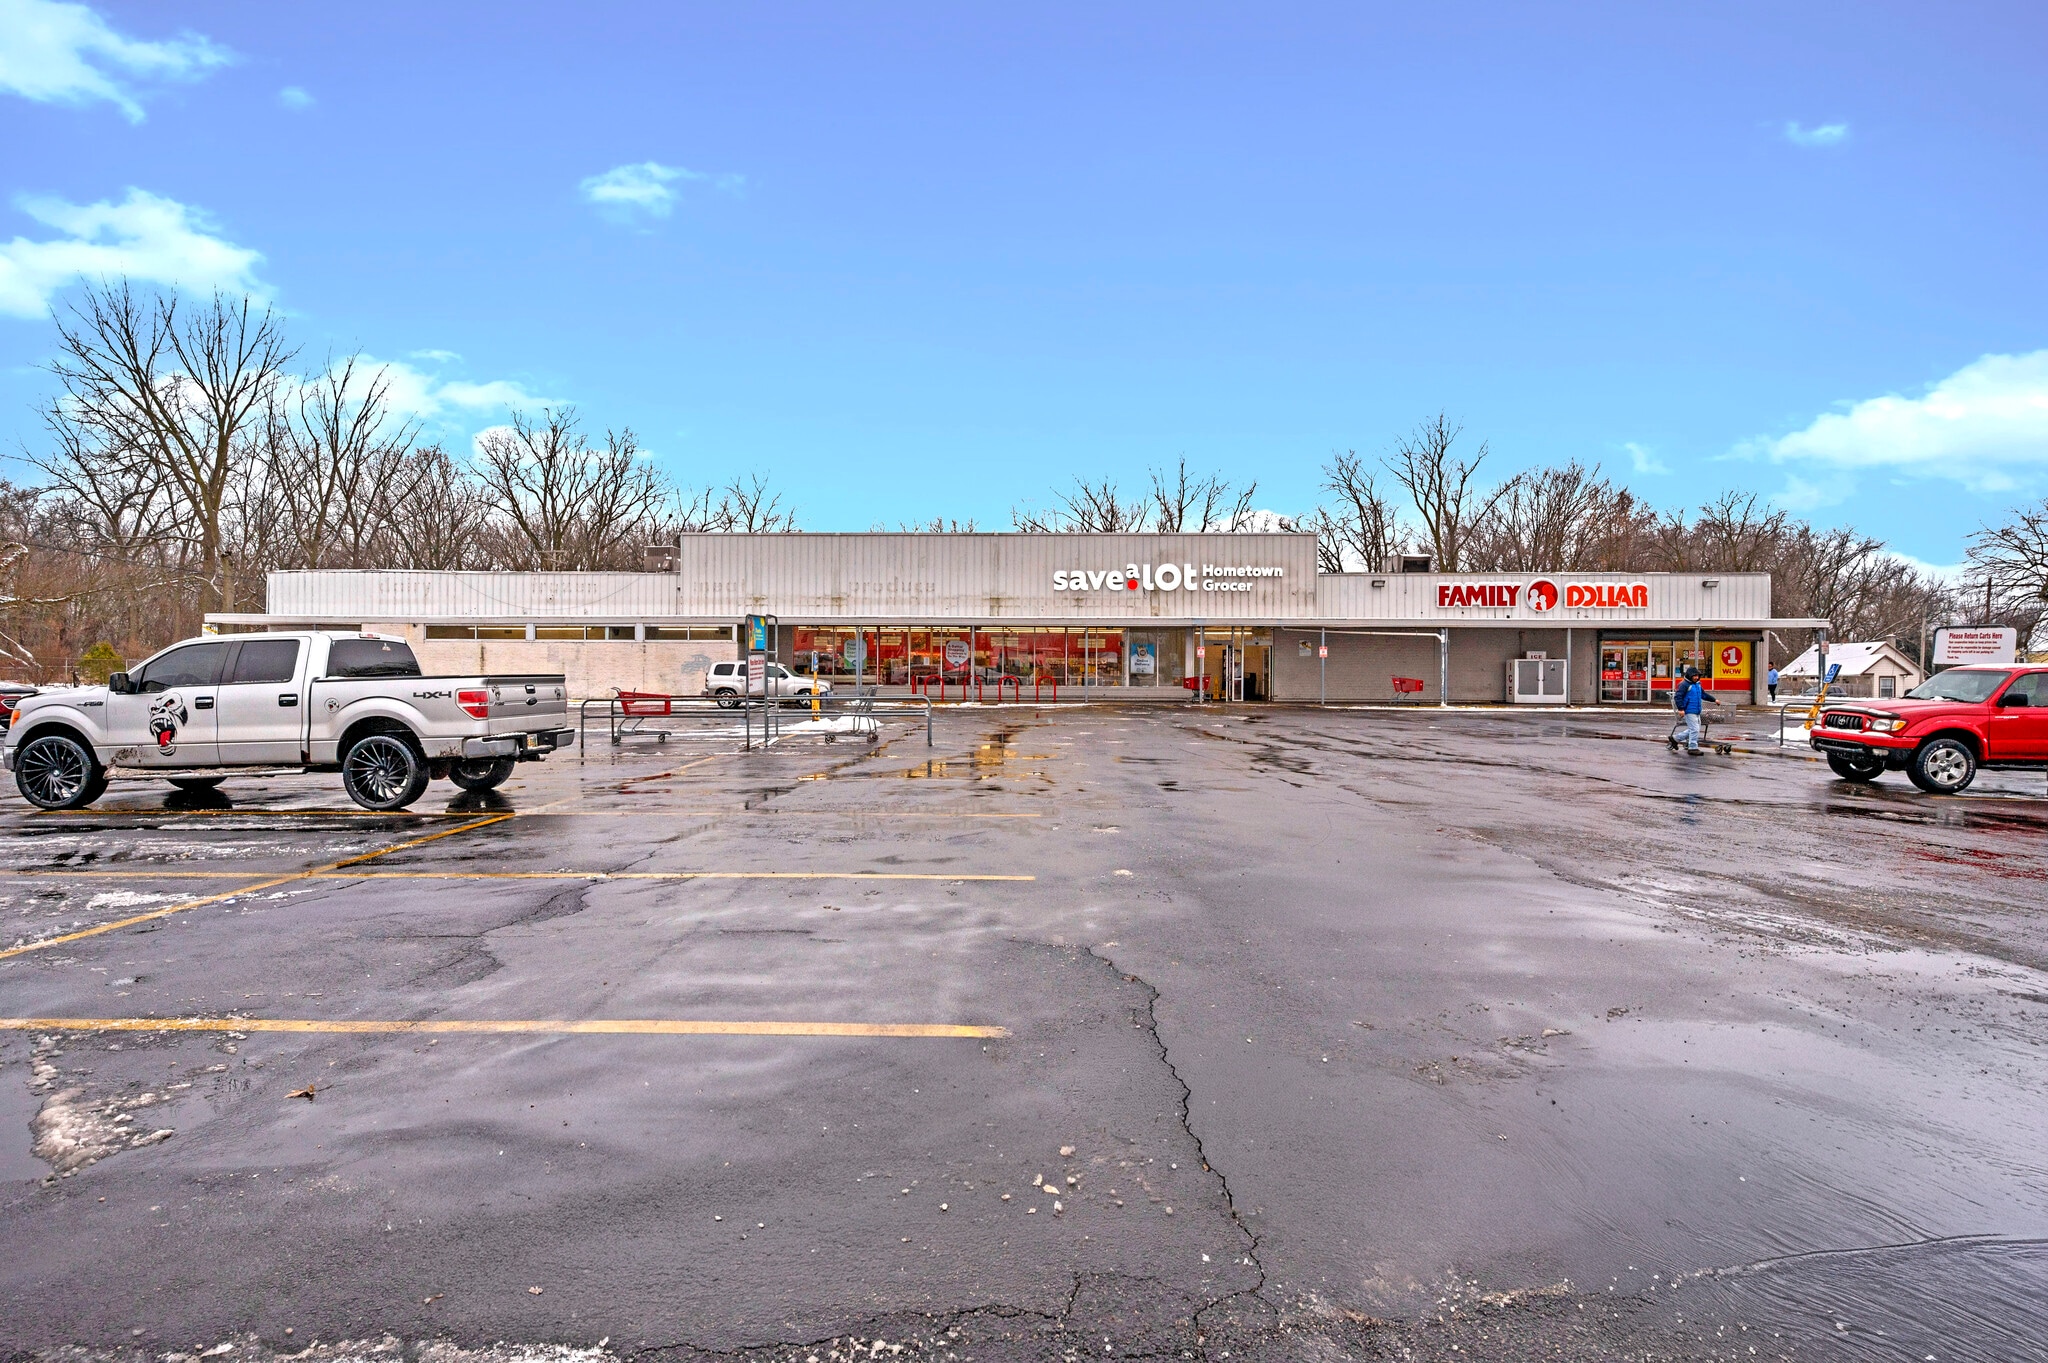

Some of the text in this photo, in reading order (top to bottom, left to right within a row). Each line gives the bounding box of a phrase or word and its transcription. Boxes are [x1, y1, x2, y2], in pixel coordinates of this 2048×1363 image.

[1202, 564, 1283, 577] Hometown
[1202, 579, 1253, 591] Grocer
[1437, 584, 1649, 607] FAMILY DOLLAR
[1722, 647, 1738, 664] $1
